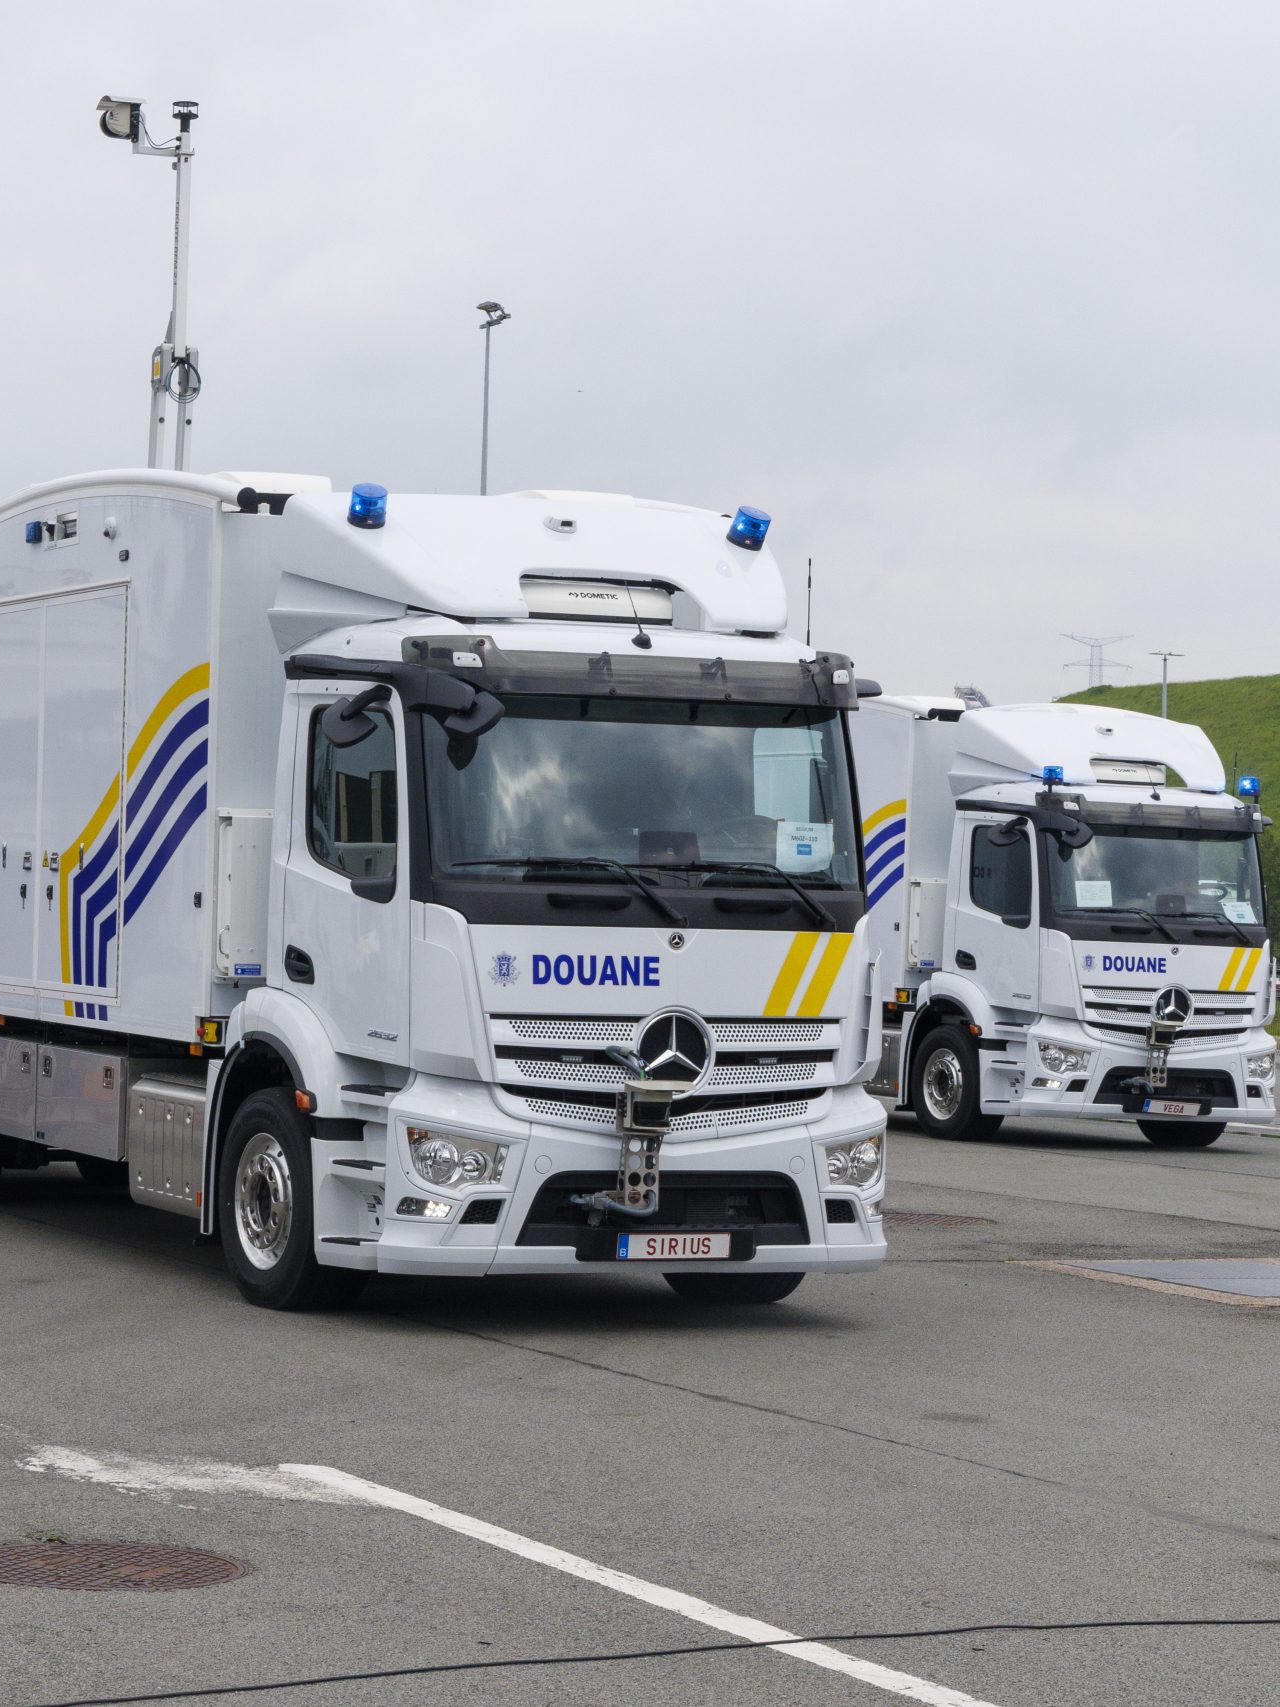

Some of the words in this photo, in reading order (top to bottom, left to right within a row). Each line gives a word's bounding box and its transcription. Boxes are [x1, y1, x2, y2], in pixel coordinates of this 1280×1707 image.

[580, 592, 619, 600] DOMETIC
[532, 954, 660, 987] DOUANE
[1102, 955, 1167, 974] DOUANE
[1163, 1103, 1185, 1114] VEGA
[619, 1248, 627, 1257] B
[646, 1237, 712, 1256] SIRIUS
